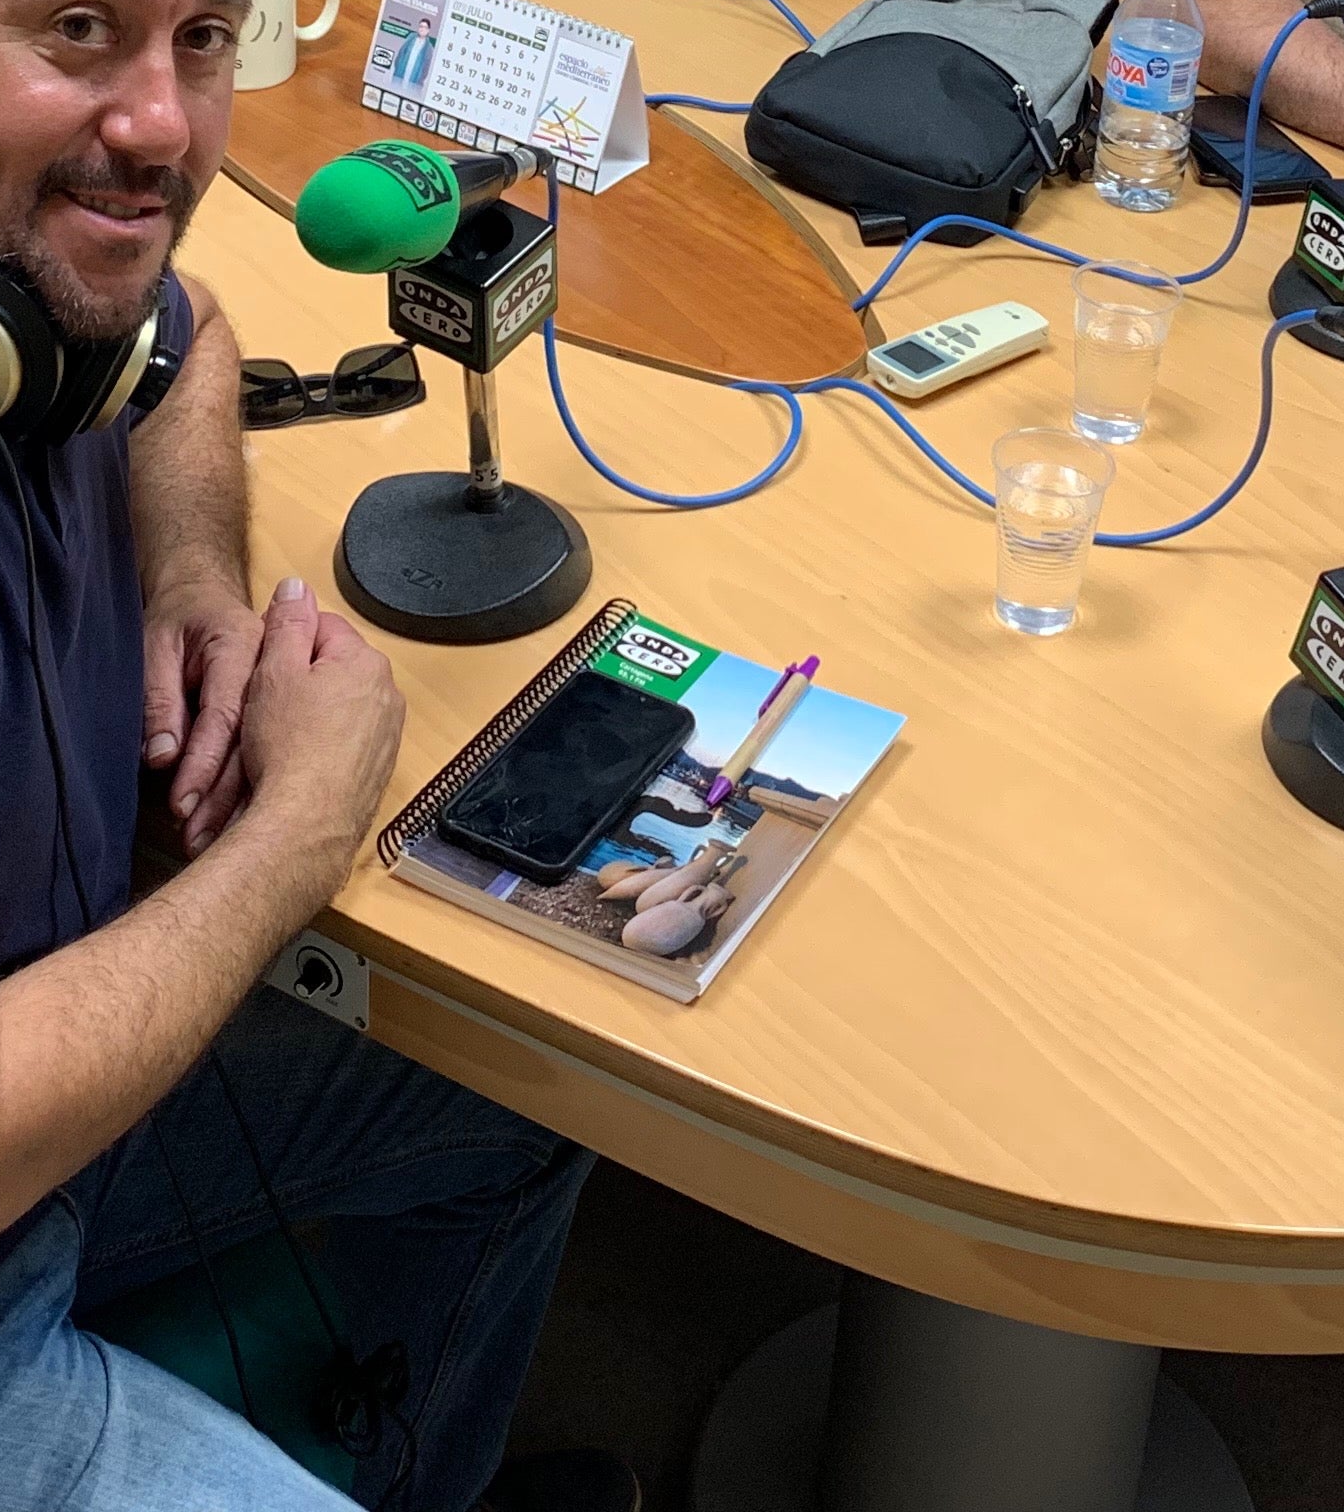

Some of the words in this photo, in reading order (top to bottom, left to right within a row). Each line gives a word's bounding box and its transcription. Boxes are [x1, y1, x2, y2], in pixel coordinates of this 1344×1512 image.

[466, 5, 493, 22] JULIO
[442, 59, 450, 69] 15
[454, 63, 464, 74] 16
[468, 69, 477, 78] 17
[481, 73, 491, 84] 18
[495, 78, 504, 88] 19
[507, 83, 517, 94] 20
[521, 88, 531, 99] 21
[472, 52, 482, 62] 10
[486, 57, 494, 66] 11
[500, 62, 508, 72] 12
[513, 66, 522, 77] 13
[527, 71, 536, 81] 14
[1108, 53, 1146, 87] OYA
[431, 91, 442, 102] 29
[444, 96, 455, 107] 30
[458, 101, 468, 112] 31
[436, 75, 446, 86] 22
[449, 80, 459, 91] 23
[462, 85, 473, 95] 24
[476, 90, 486, 101] 25
[489, 95, 499, 106] 26
[502, 100, 513, 110] 27
[515, 105, 527, 116] 28
[1309, 236, 1340, 266] CERO
[405, 282, 462, 318] ONDA
[501, 268, 544, 314] ONDA
[409, 306, 462, 338] CERO
[504, 289, 544, 332] CERO
[627, 647, 674, 670] CERO
[634, 633, 684, 661] ONDA
